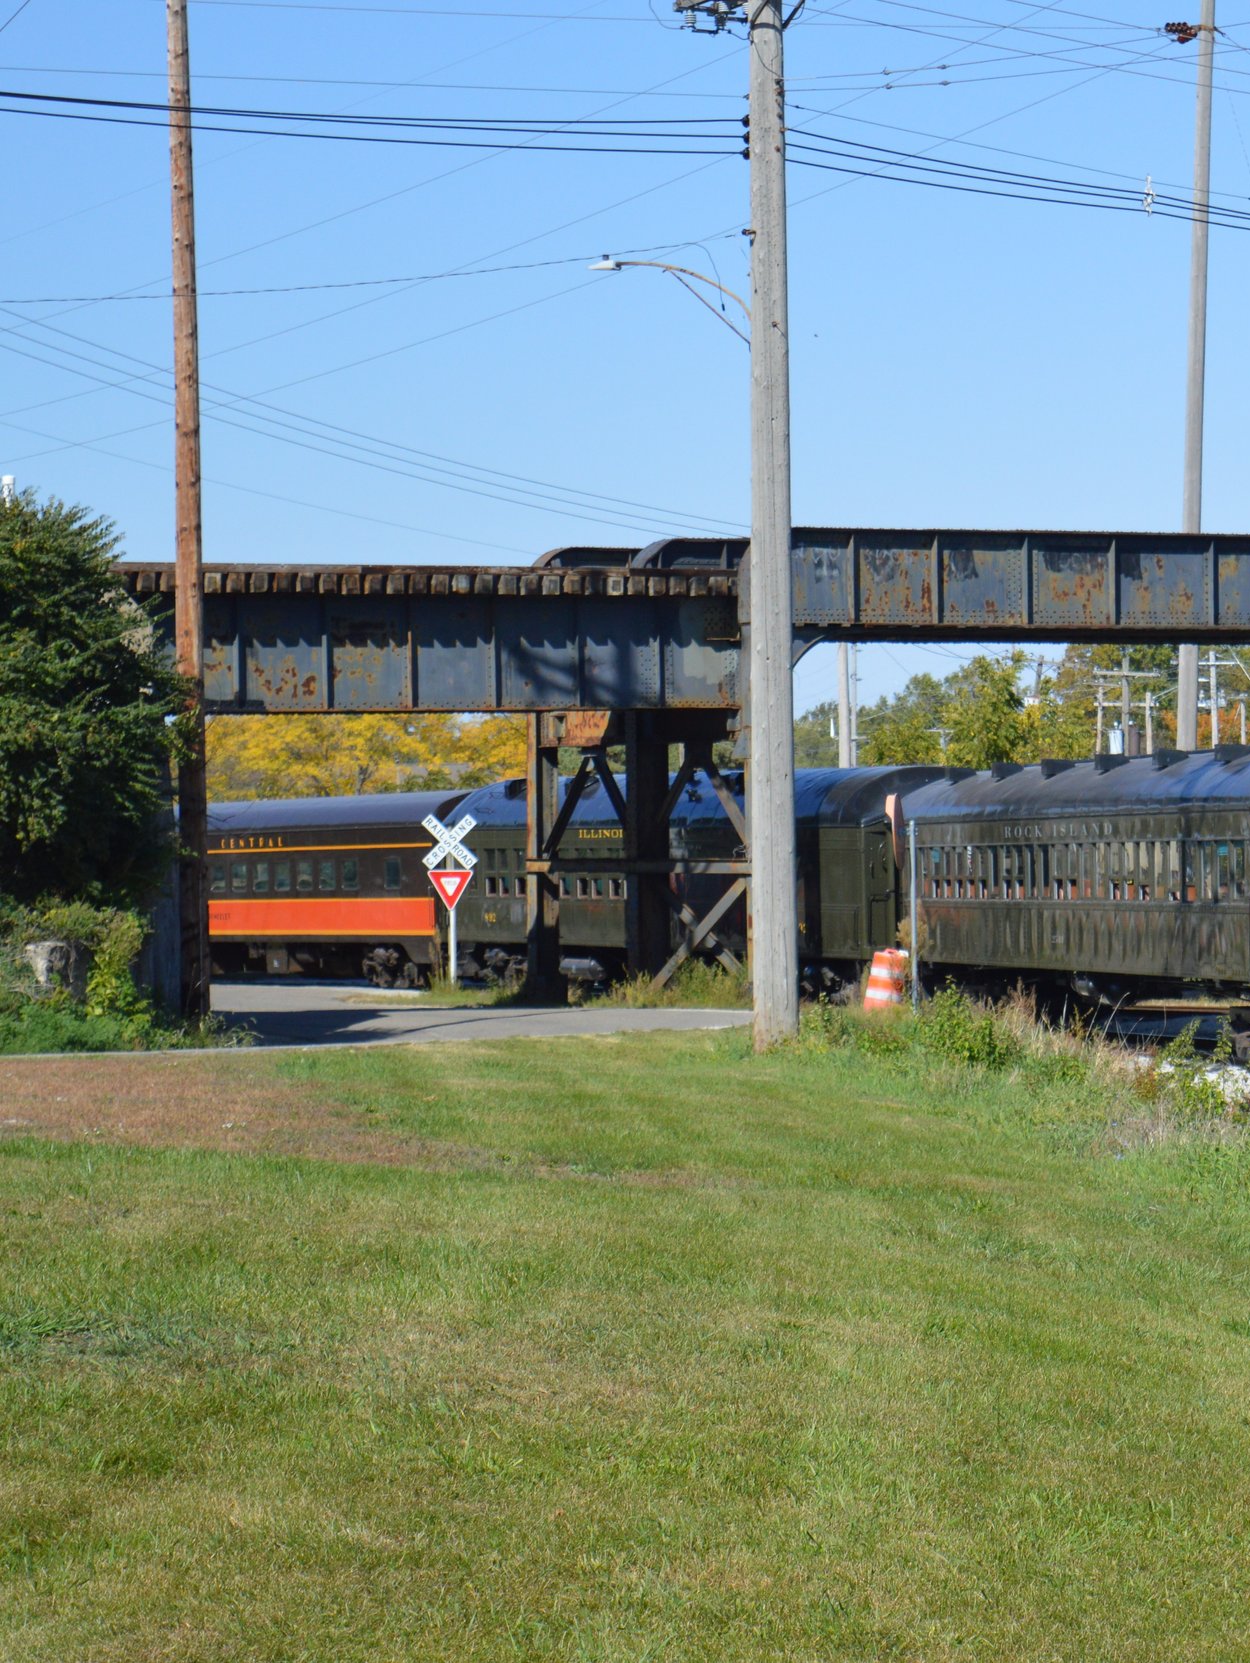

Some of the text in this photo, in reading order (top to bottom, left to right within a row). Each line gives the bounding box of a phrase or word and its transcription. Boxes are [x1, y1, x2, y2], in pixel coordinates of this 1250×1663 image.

[579, 829, 624, 839] ILLINOI
[1004, 823, 1113, 838] ROCK ISLAND
[221, 836, 283, 849] CENTRAL
[425, 818, 473, 867] RAIL ROAD
[426, 818, 473, 866] CROSSING
